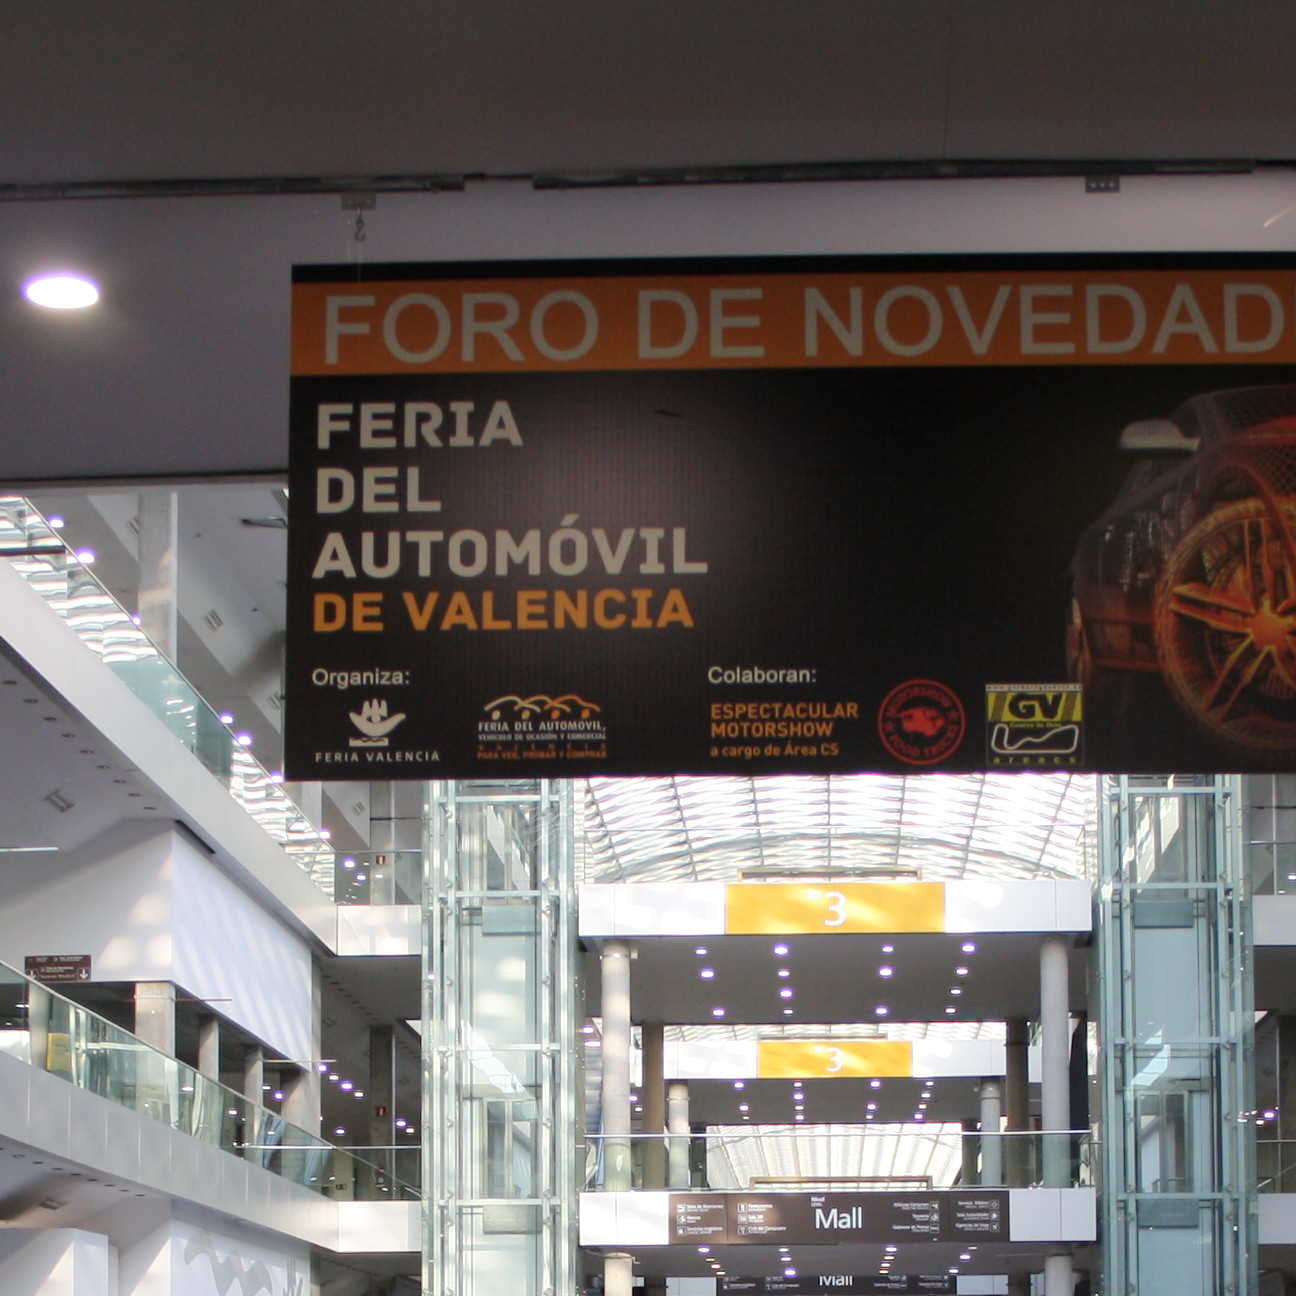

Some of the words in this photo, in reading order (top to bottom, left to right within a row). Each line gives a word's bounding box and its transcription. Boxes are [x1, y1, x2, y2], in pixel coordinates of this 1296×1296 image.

[324, 291, 599, 364] FORO
[638, 287, 765, 359] DE
[316, 401, 523, 449] FERIA
[316, 466, 442, 514] DEL
[312, 514, 708, 579] AUTOMÓVIL
[313, 592, 384, 632] DE
[402, 588, 694, 631] VALENCIA
[312, 668, 410, 689] Organiza:
[707, 666, 816, 683] Colaboran:
[711, 702, 859, 719] ESPECTACULAR
[1008, 692, 1062, 719] GV
[478, 721, 509, 731] FERIA
[514, 721, 533, 731] DEL
[711, 721, 833, 737] MOTORSHOW
[315, 752, 359, 762] FERIA
[366, 751, 440, 762] VALENCIA
[722, 746, 761, 760] cargo
[764, 744, 781, 757] de
[821, 743, 839, 756] CS
[823, 891, 847, 927] 3
[826, 1047, 844, 1073] 3
[815, 1206, 862, 1229] Mall
[819, 1276, 853, 1287] Mall
